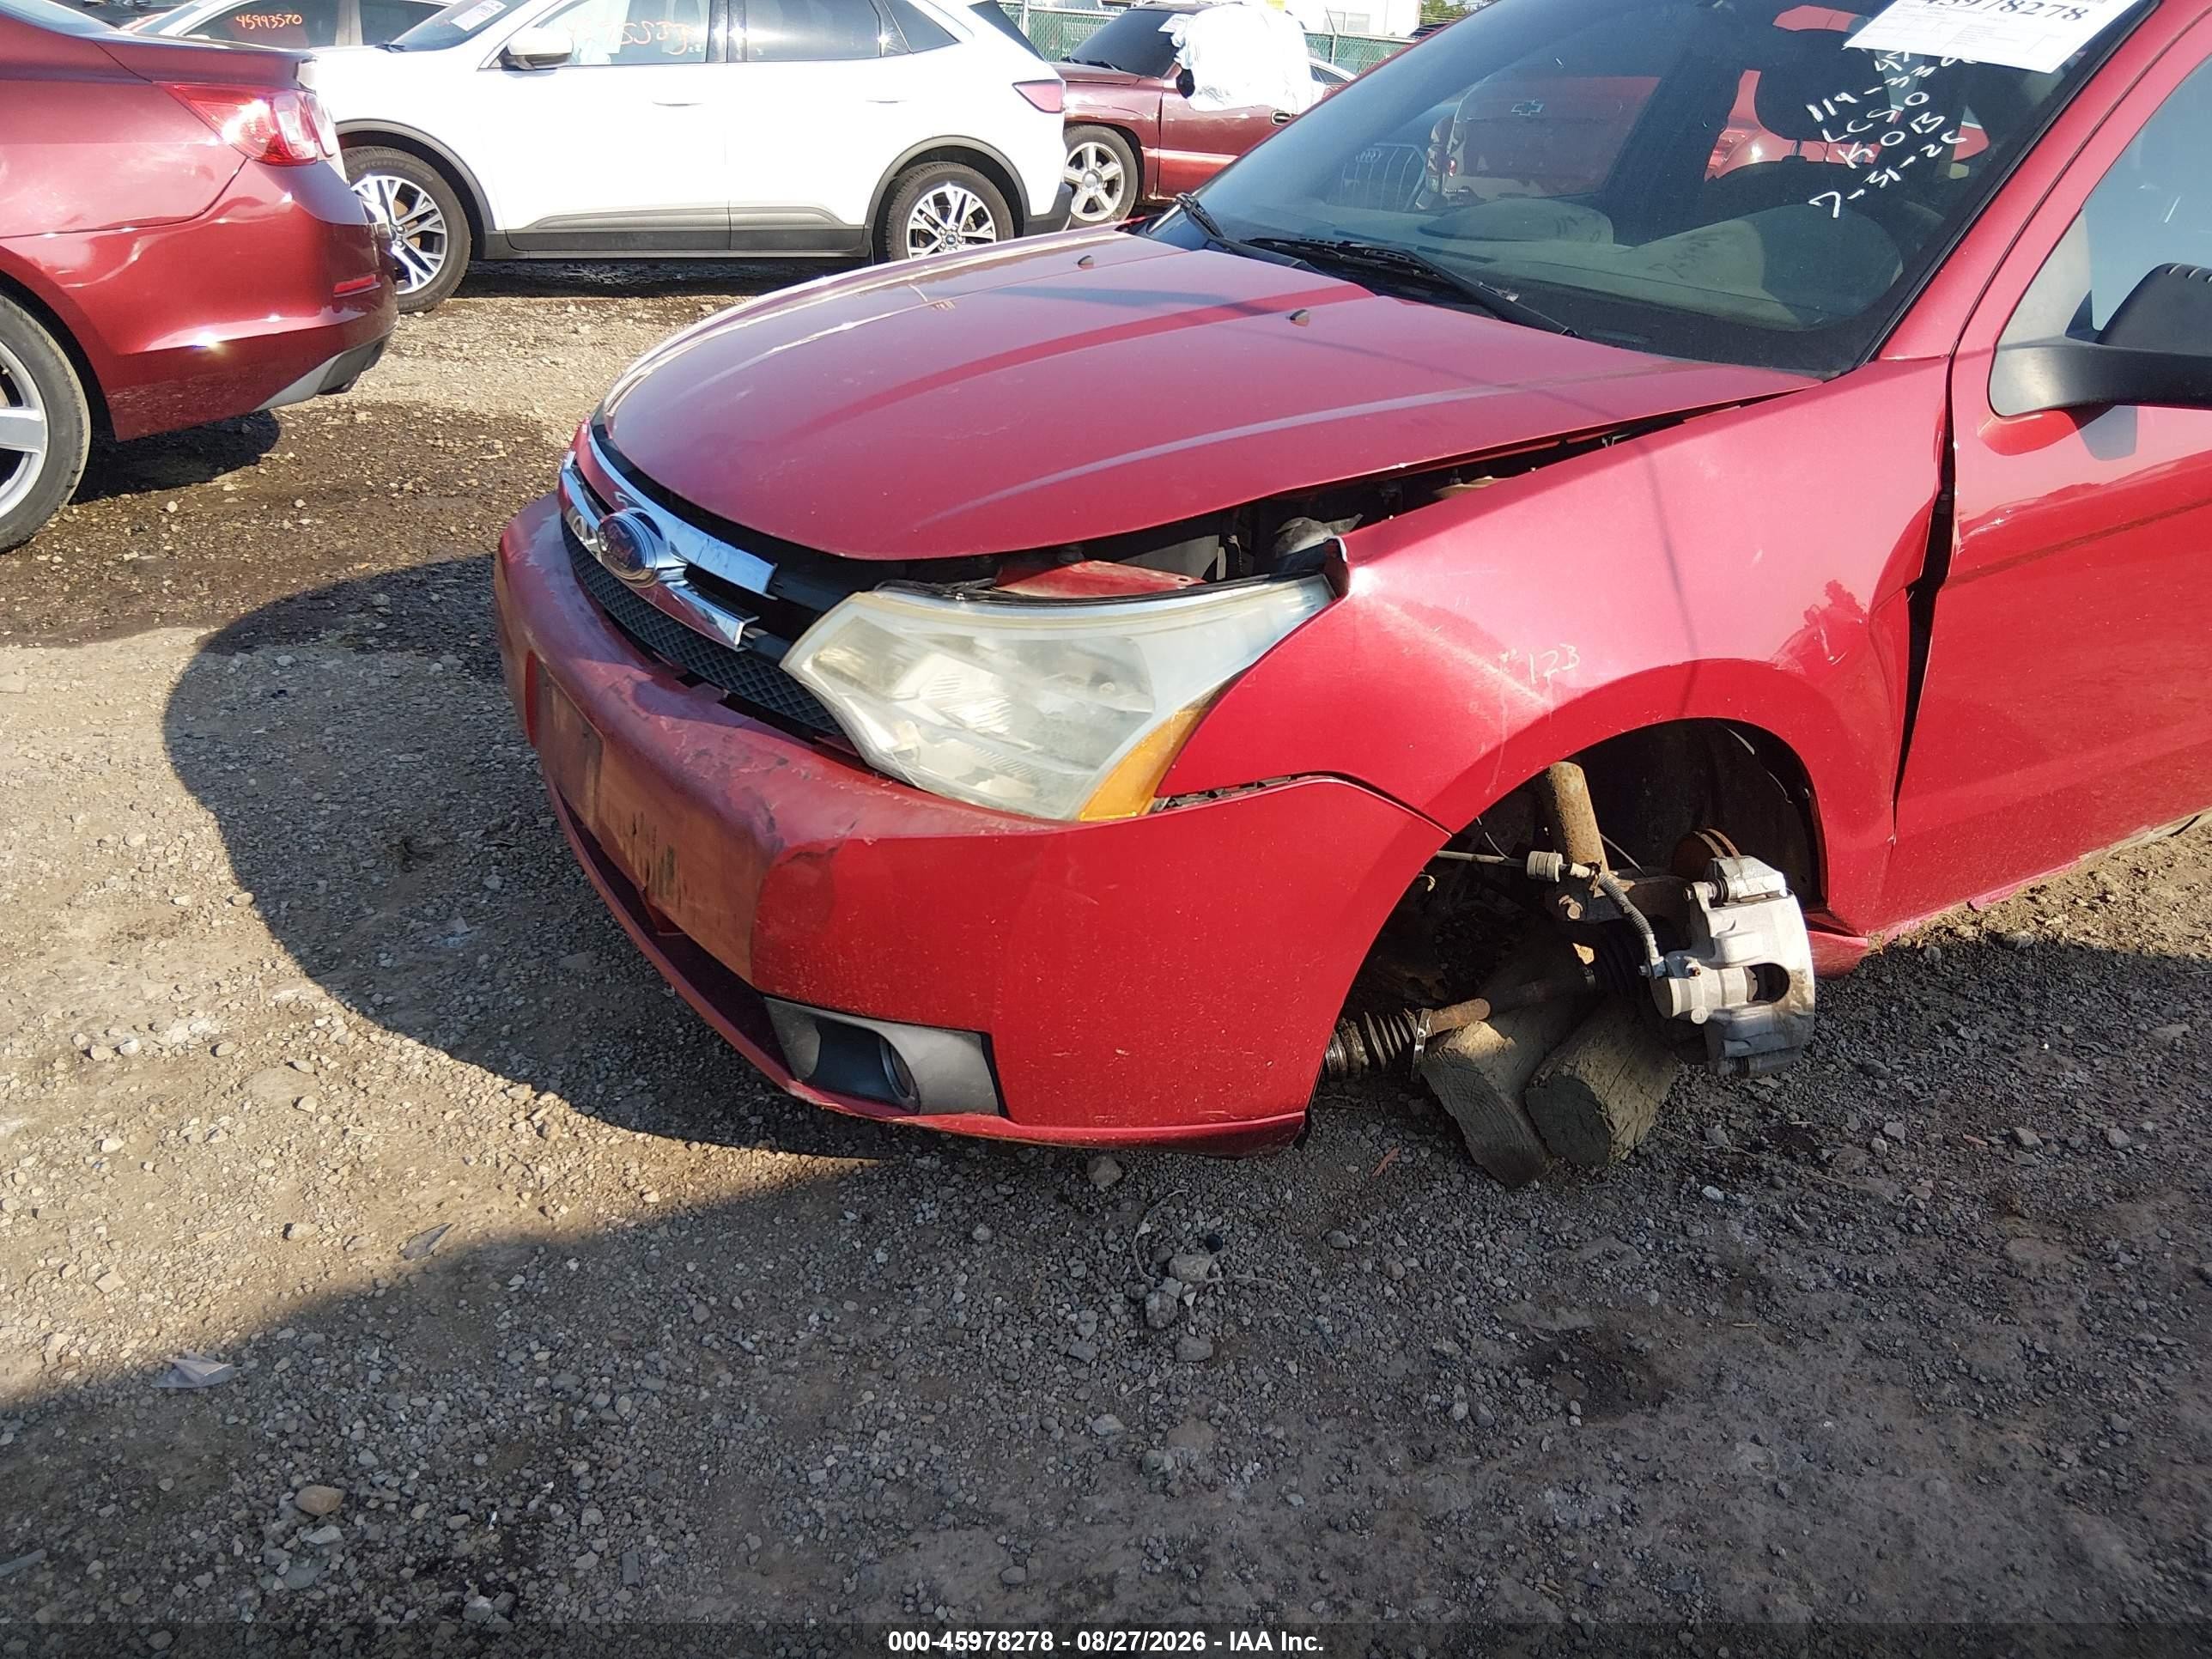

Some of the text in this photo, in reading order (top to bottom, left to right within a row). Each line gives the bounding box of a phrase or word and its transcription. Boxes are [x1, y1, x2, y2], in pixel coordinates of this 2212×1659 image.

[1925, 0, 2089, 21] 78278
[235, 13, 303, 30] 45993570
[1808, 129, 1968, 219] 7-31-26
